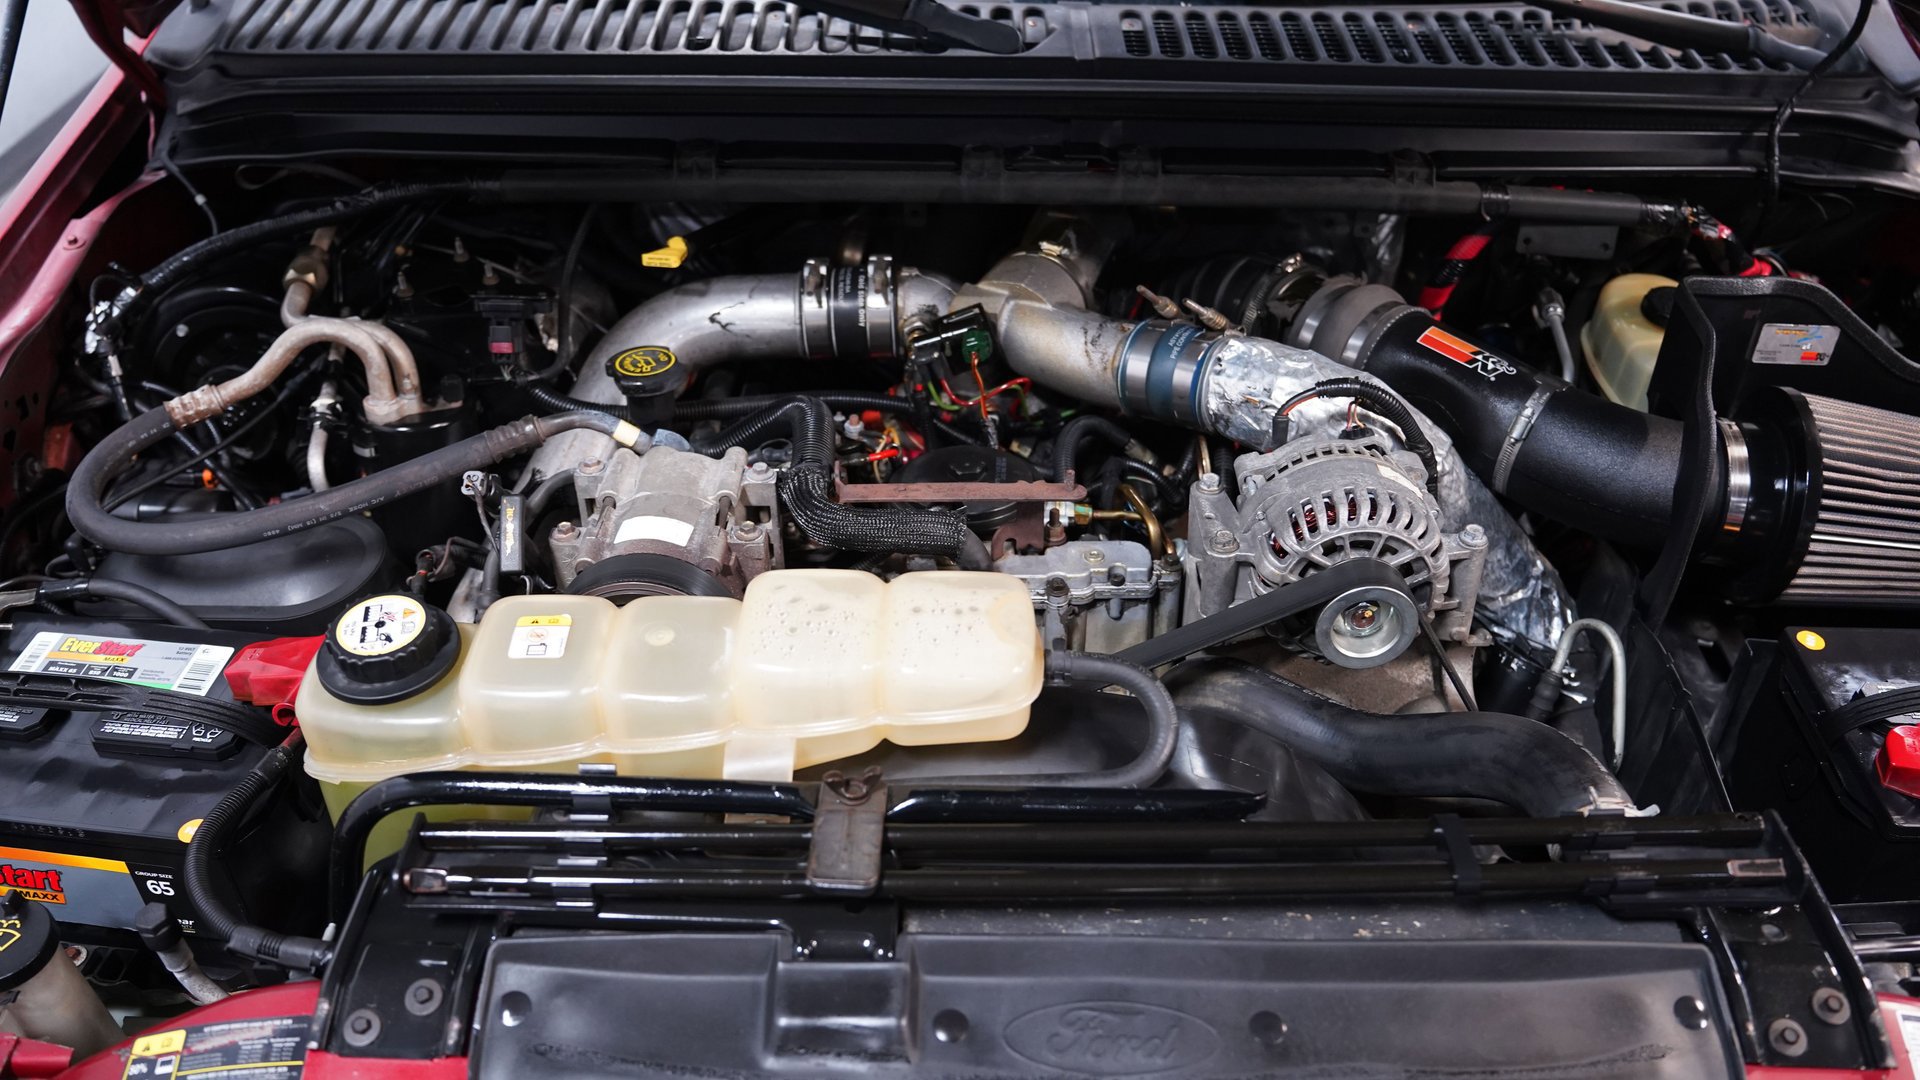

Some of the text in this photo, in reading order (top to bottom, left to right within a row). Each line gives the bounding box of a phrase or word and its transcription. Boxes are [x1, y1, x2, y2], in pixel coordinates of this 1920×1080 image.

[857, 308, 866, 327] Only
[60, 637, 144, 657] EverStart
[146, 880, 175, 896] 65
[1046, 1006, 1181, 1063] Ford
